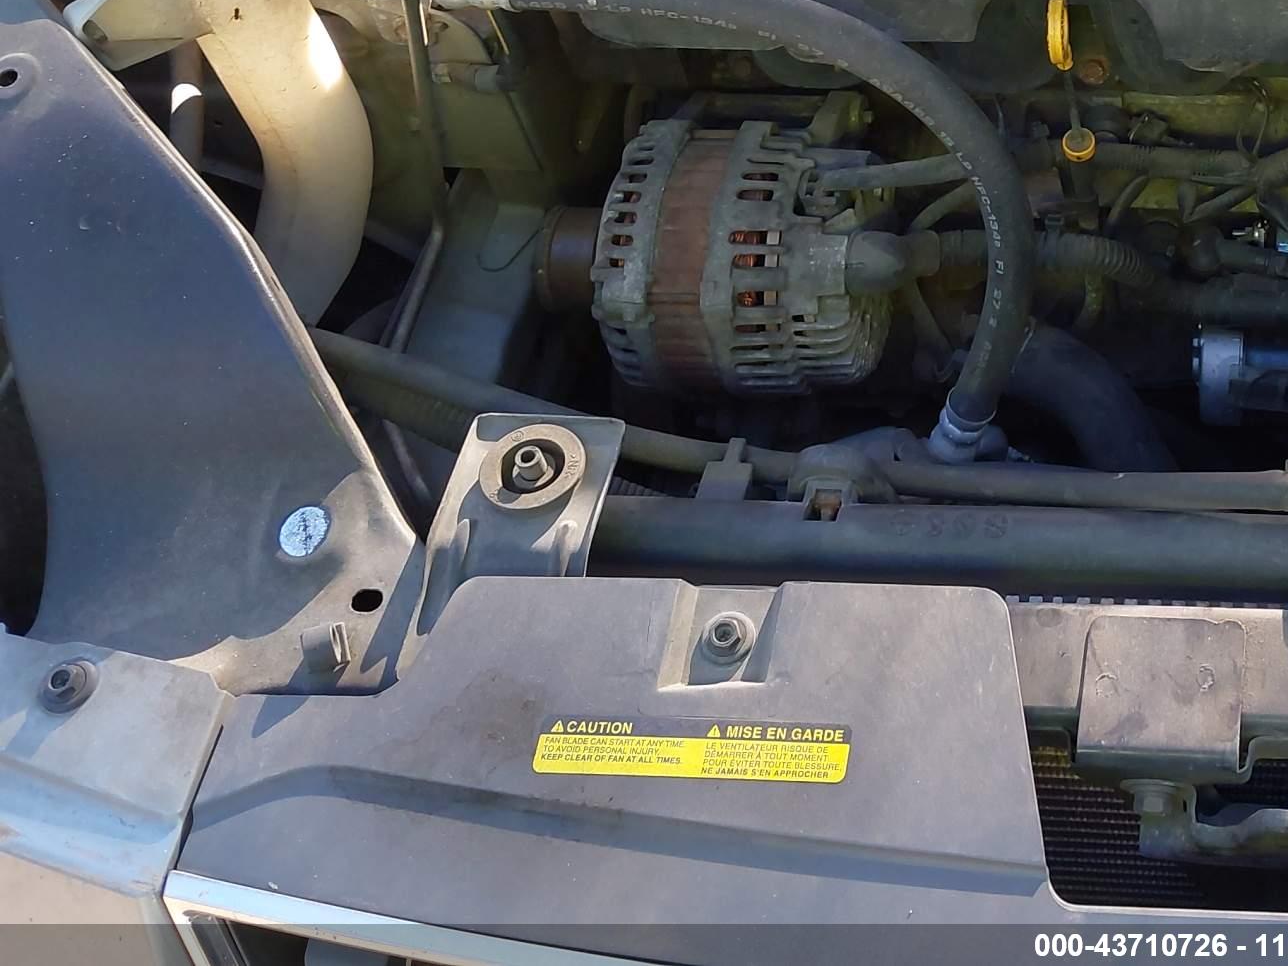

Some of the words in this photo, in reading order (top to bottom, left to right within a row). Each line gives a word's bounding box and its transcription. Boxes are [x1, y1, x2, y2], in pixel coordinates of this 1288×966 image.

[567, 721, 633, 734] CAUTION
[726, 725, 762, 739] MISE
[767, 727, 787, 740] EN
[792, 728, 844, 742] GARDE
[720, 743, 778, 752] VENTILATEUR
[781, 745, 814, 753] RISQUE
[704, 750, 753, 759] DÉMARRER
[730, 759, 760, 767] ÉVITER
[795, 762, 842, 771] BLESSURE,
